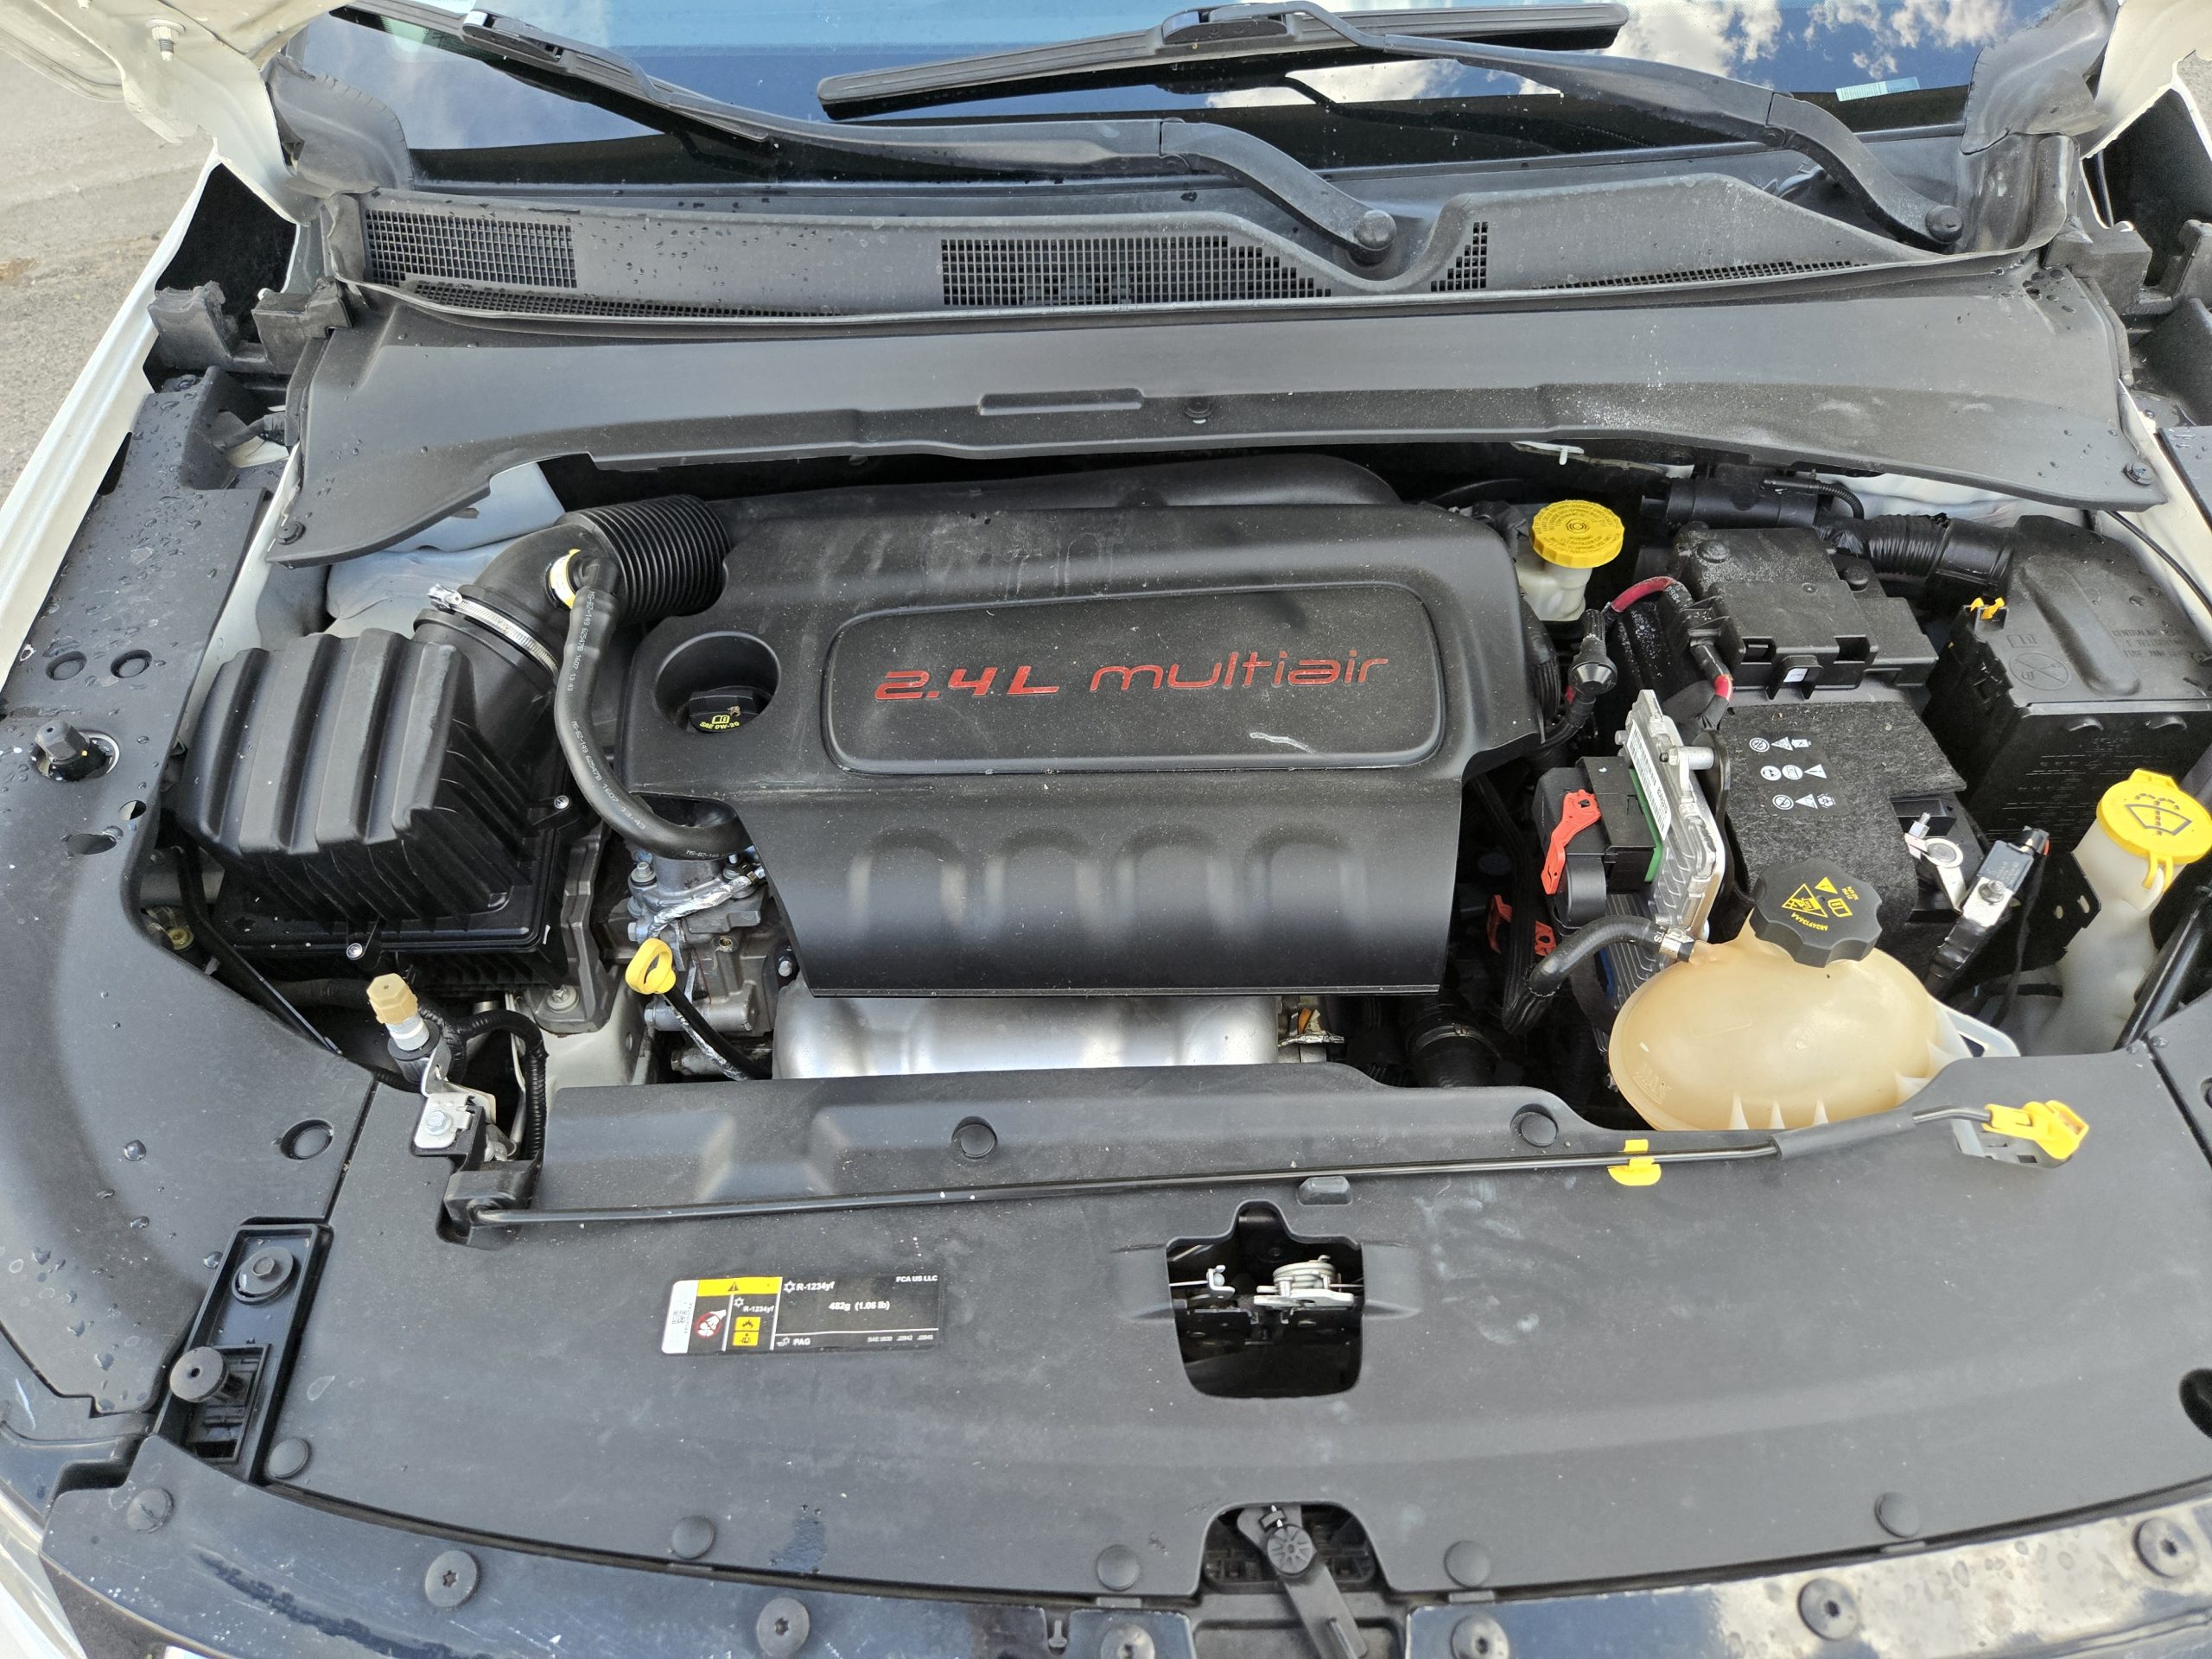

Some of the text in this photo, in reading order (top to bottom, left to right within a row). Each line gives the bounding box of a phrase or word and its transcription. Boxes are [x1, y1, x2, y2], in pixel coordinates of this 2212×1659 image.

[874, 648, 1389, 701] 2.4L multiair
[796, 1281, 835, 1292] R-1234yf
[742, 1305, 775, 1313] R-1234yf
[828, 1301, 851, 1312] 482g
[792, 1338, 811, 1346] PAG
